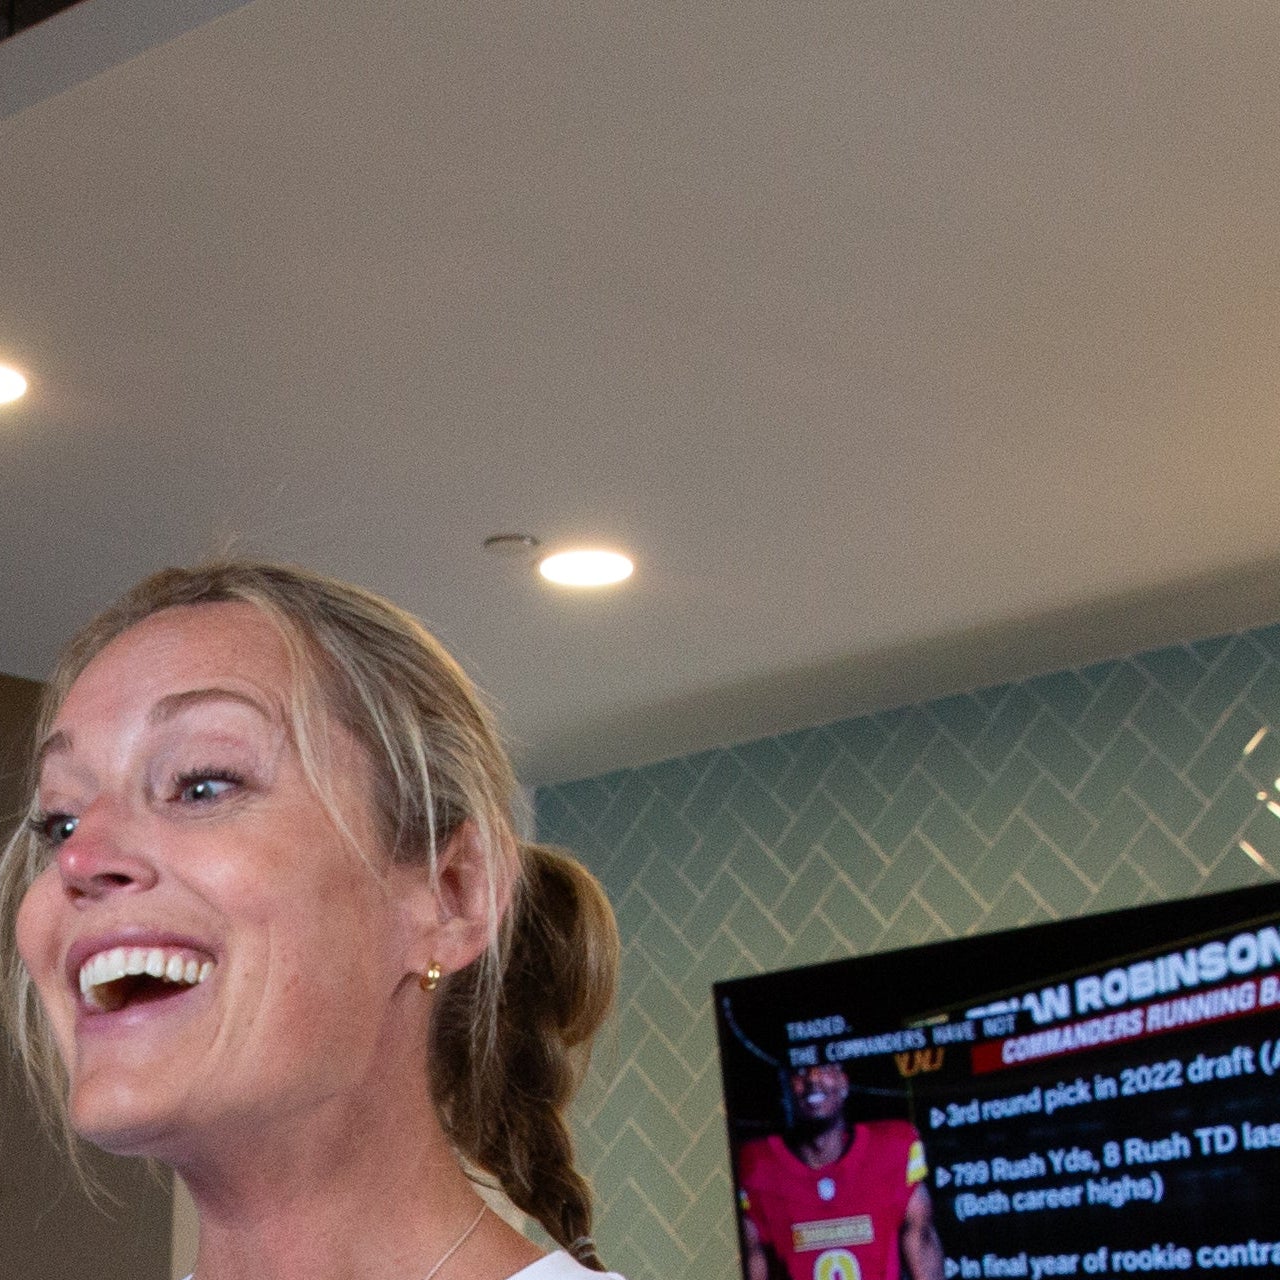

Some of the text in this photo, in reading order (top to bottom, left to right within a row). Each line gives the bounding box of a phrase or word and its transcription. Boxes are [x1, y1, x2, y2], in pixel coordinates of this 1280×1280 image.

[789, 1013, 1016, 1068] THE COMMANDERS HAVE NOT
[1002, 1008, 1145, 1065] COMMANDERS
[1146, 980, 1257, 1032] RUNNING
[946, 1099, 981, 1128] 3rd
[982, 1087, 1042, 1121] round
[1044, 1078, 1091, 1115] pick
[1094, 1074, 1117, 1100] in
[1120, 1059, 1184, 1096] 2022
[1186, 1046, 1255, 1083] draft
[992, 1153, 1046, 1182] Rush
[1048, 1147, 1101, 1175] Yds,
[1103, 1141, 1121, 1168] 8
[1123, 1131, 1191, 1165] Rush
[1193, 1124, 1237, 1154] TD
[954, 1170, 1164, 1221] (Both career highs)
[982, 1251, 1029, 1279] final
[1030, 1254, 1080, 1280] year
[1083, 1246, 1109, 1274] of
[1112, 1242, 1191, 1273] rookie
